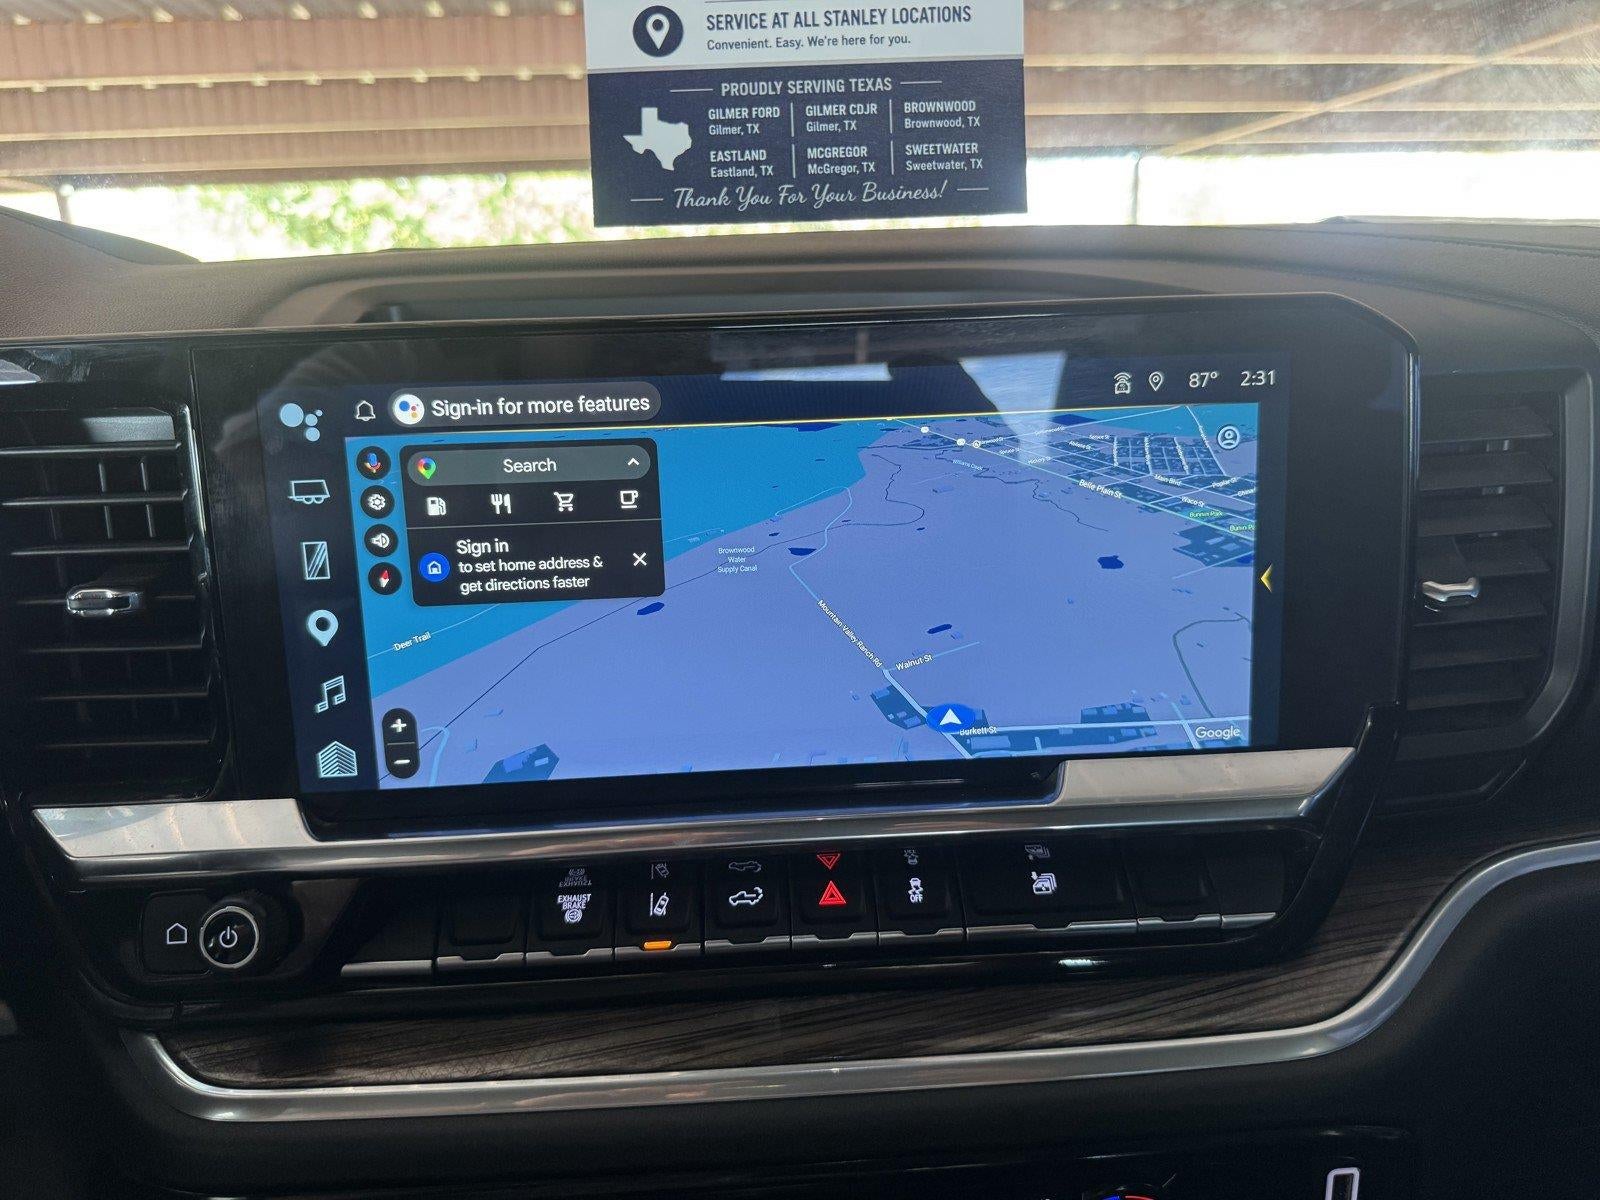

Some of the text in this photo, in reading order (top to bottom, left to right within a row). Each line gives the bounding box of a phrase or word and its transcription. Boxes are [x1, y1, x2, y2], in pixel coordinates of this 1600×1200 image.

[706, 5, 971, 31] SERVICE AT ALL STANLEY LOCATIONS
[707, 34, 911, 50] Convenient. Easy. We're here for you.
[721, 77, 892, 97] PROUDLY SERVING TEXAS
[708, 106, 780, 120] GILMER FORD
[805, 102, 877, 117] GILMER CDJR
[904, 100, 976, 113] BROWNWOOD
[709, 123, 760, 136] Gilmer, TX
[806, 120, 857, 132] Gilmer, TX
[904, 116, 980, 129] Brownwood, TX
[709, 149, 767, 162] EASTLAND
[806, 146, 868, 159] MCGREGOR
[905, 142, 979, 156] SWEETWATER
[710, 165, 774, 178] Eastland, TX
[807, 161, 876, 176] McGregor, TX
[906, 158, 983, 172] Sweetwater, TX
[674, 179, 948, 211] Thank You For Your Business!
[1240, 370, 1275, 387] 2:31
[431, 394, 650, 420] Sign-in for more features
[502, 457, 557, 473] Search
[456, 537, 509, 558] Sign in
[718, 546, 755, 554] Brownwood
[458, 554, 604, 573] to set home address &
[717, 566, 739, 574] Supply
[459, 575, 590, 595] get directions faster
[818, 599, 882, 668] Mountain Valley Ranch Rd
[393, 631, 431, 651] Deer Trail
[895, 654, 933, 671] Walnut St
[988, 726, 997, 734] St
[1195, 725, 1241, 740] Google
[557, 893, 592, 904] EXHAUST
[910, 894, 923, 903] OFF
[562, 901, 586, 911] BRAKE
